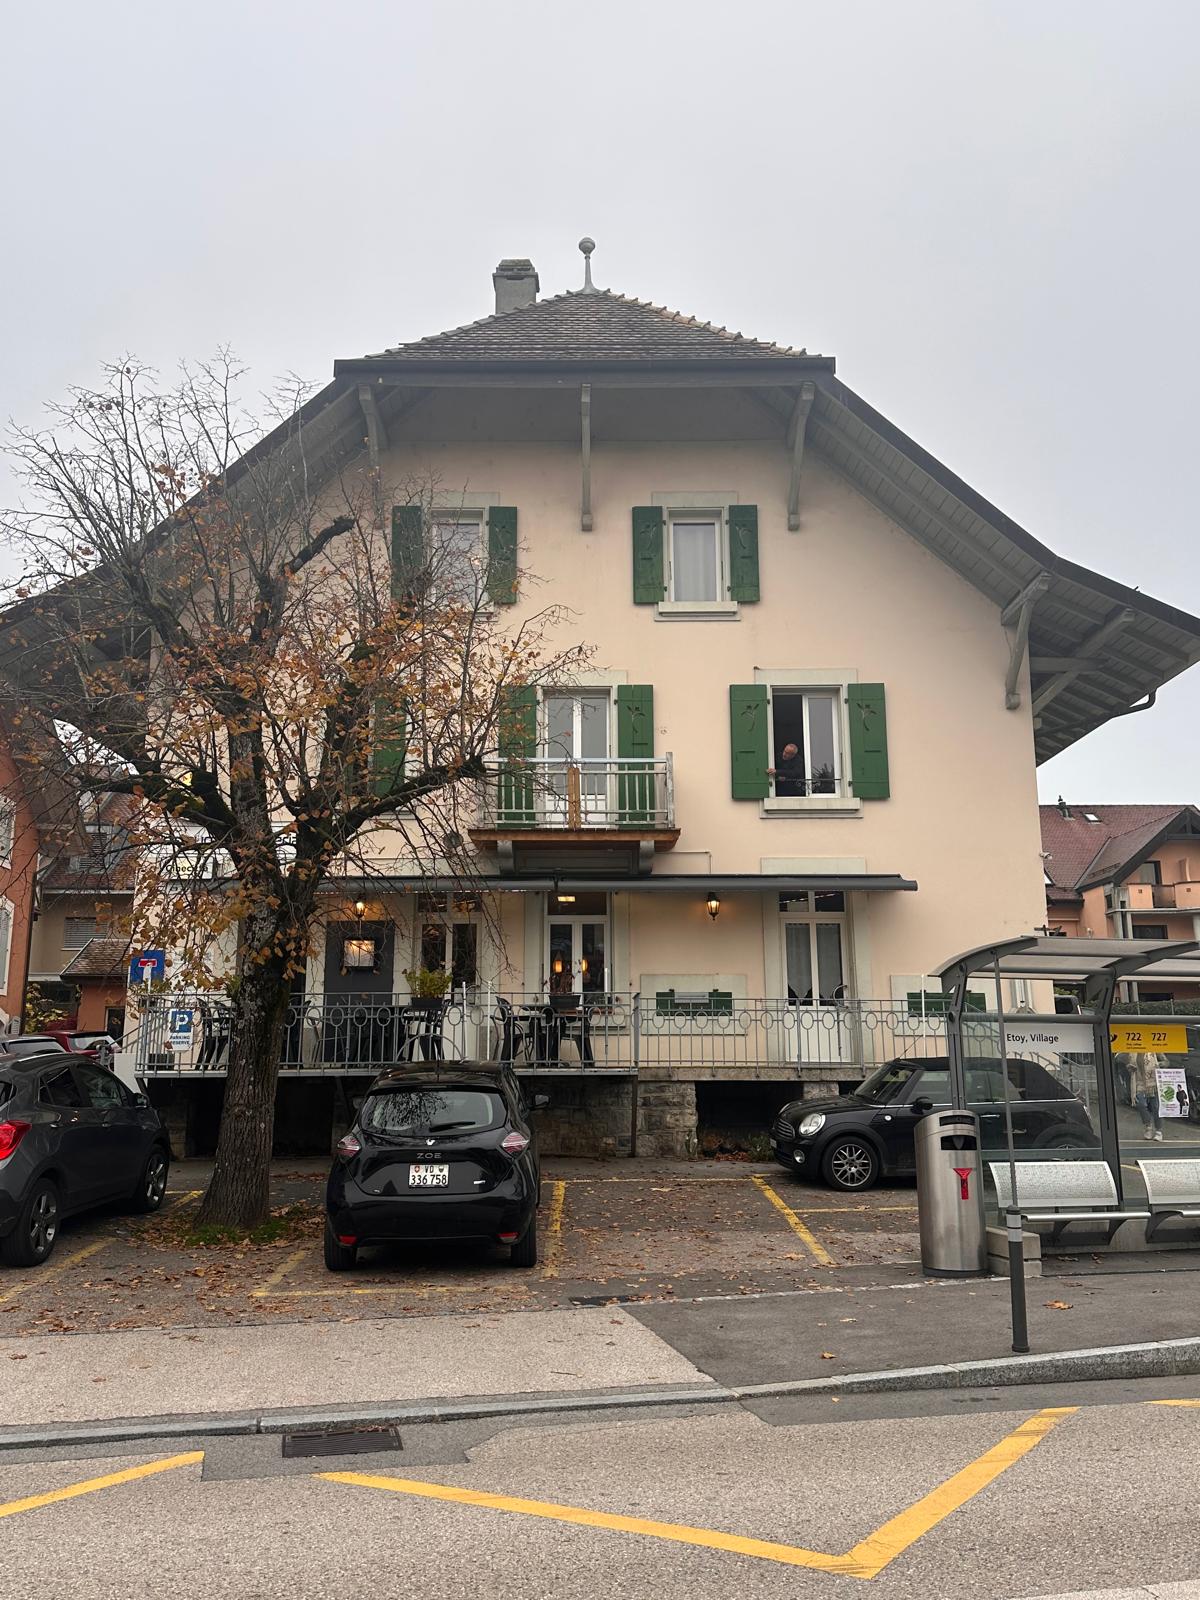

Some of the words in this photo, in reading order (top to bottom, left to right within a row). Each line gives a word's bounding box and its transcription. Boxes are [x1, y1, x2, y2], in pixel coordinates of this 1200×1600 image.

[175, 1014, 189, 1031] P
[1006, 1033, 1028, 1043] Etoy,
[1029, 1033, 1059, 1044] Village
[1125, 1032, 1142, 1041] 722
[1151, 1032, 1167, 1041] 727
[424, 1165, 435, 1173] VD
[411, 1174, 428, 1185] 336
[429, 1174, 447, 1185] 758
